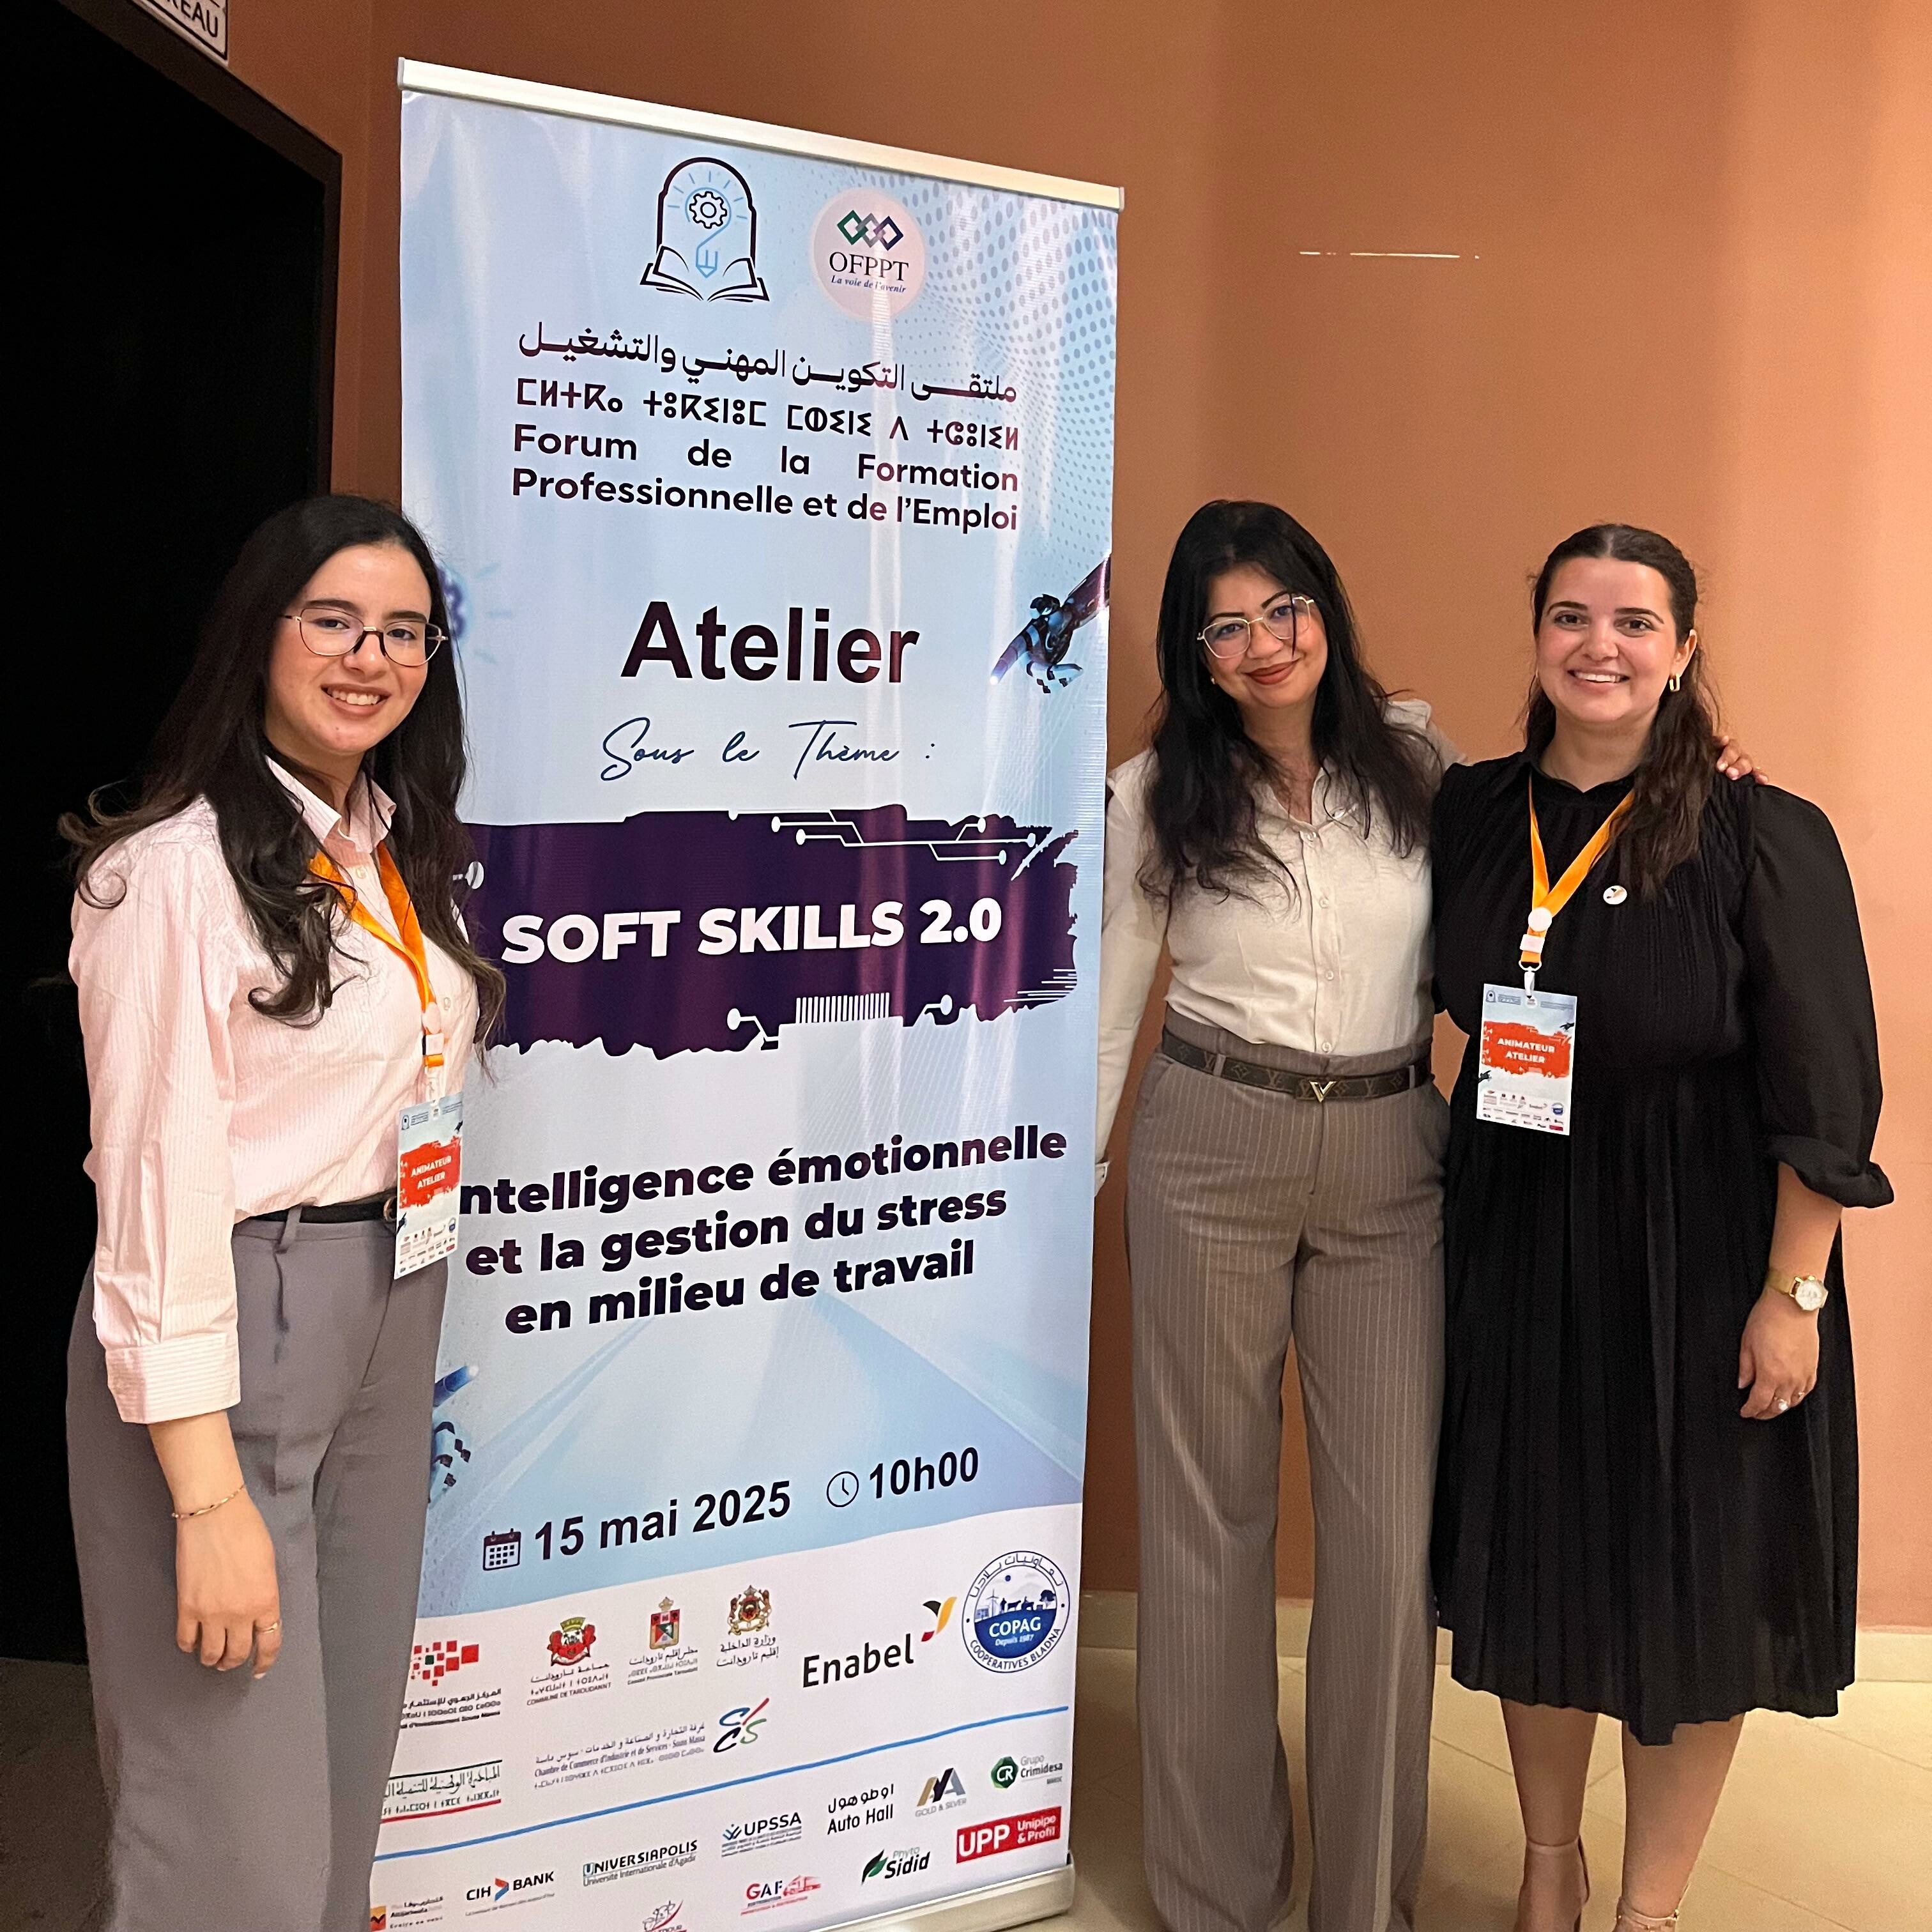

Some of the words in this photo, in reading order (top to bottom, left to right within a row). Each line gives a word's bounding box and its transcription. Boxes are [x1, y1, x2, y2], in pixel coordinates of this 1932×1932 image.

[167, 0, 218, 37] EAU
[829, 252, 909, 281] OFPPT
[831, 275, 843, 284] La
[845, 278, 862, 287] voie
[863, 280, 873, 289] de
[514, 424, 638, 461] Forum
[687, 438, 732, 468] de
[781, 445, 810, 475] la
[858, 453, 1018, 491] Formation
[512, 468, 793, 514] Professionnelle
[803, 493, 838, 518] et
[847, 493, 887, 521] de
[620, 601, 920, 684] Atelier
[601, 717, 695, 781] Sous
[722, 731, 760, 763] le
[788, 720, 900, 781] Thème
[502, 910, 681, 964] SOFT
[697, 901, 905, 955] SKILLS
[919, 897, 1002, 944] 2.0
[1497, 1038, 1555, 1054] ANIMATEUR
[1505, 1050, 1545, 1064] ATELIER
[410, 1155, 452, 1177] ANIMATEUR
[417, 1172, 446, 1189] ATELIER
[459, 1164, 754, 1214] ntelligence
[768, 1124, 1067, 1186] émotionnelle
[466, 1239, 523, 1276] et
[540, 1233, 584, 1271] la
[601, 1209, 788, 1272] gestion
[804, 1202, 864, 1239] du
[877, 1190, 1007, 1230] stress
[505, 1300, 571, 1334] en
[588, 1272, 744, 1324] milieu
[760, 1263, 820, 1301] de
[833, 1238, 974, 1293] travail
[534, 1516, 585, 1560] 15
[601, 1499, 677, 1550] mai
[693, 1480, 791, 1533] 2025
[869, 1446, 979, 1500] 10h00
[989, 1616, 1041, 1637] COPAG
[1030, 1629, 1061, 1662] BLADNA
[803, 1633, 914, 1688] Enabel
[997, 1765, 1013, 1781] CR
[1021, 1755, 1045, 1766] Grupo
[1021, 1763, 1063, 1777] Crimidesa
[827, 1814, 861, 1835] Auto
[866, 1804, 894, 1825] Hall
[915, 1805, 937, 1818] GOLD
[945, 1798, 967, 1810] SILVER
[744, 1812, 802, 1837] UPSSA
[1017, 1815, 1056, 1831] Unipipe
[1018, 1832, 1026, 1844] &
[1027, 1826, 1055, 1841] Profil
[893, 1846, 921, 1859] Phyto
[959, 1824, 1010, 1857] UPP
[583, 1840, 698, 1876] UNIVERSIAPOLIS
[620, 1860, 667, 1878] Internationale
[884, 1851, 930, 1880] Sidid
[466, 1886, 491, 1901] CIH
[512, 1871, 555, 1891] BANK
[746, 1880, 783, 1901] GAF
